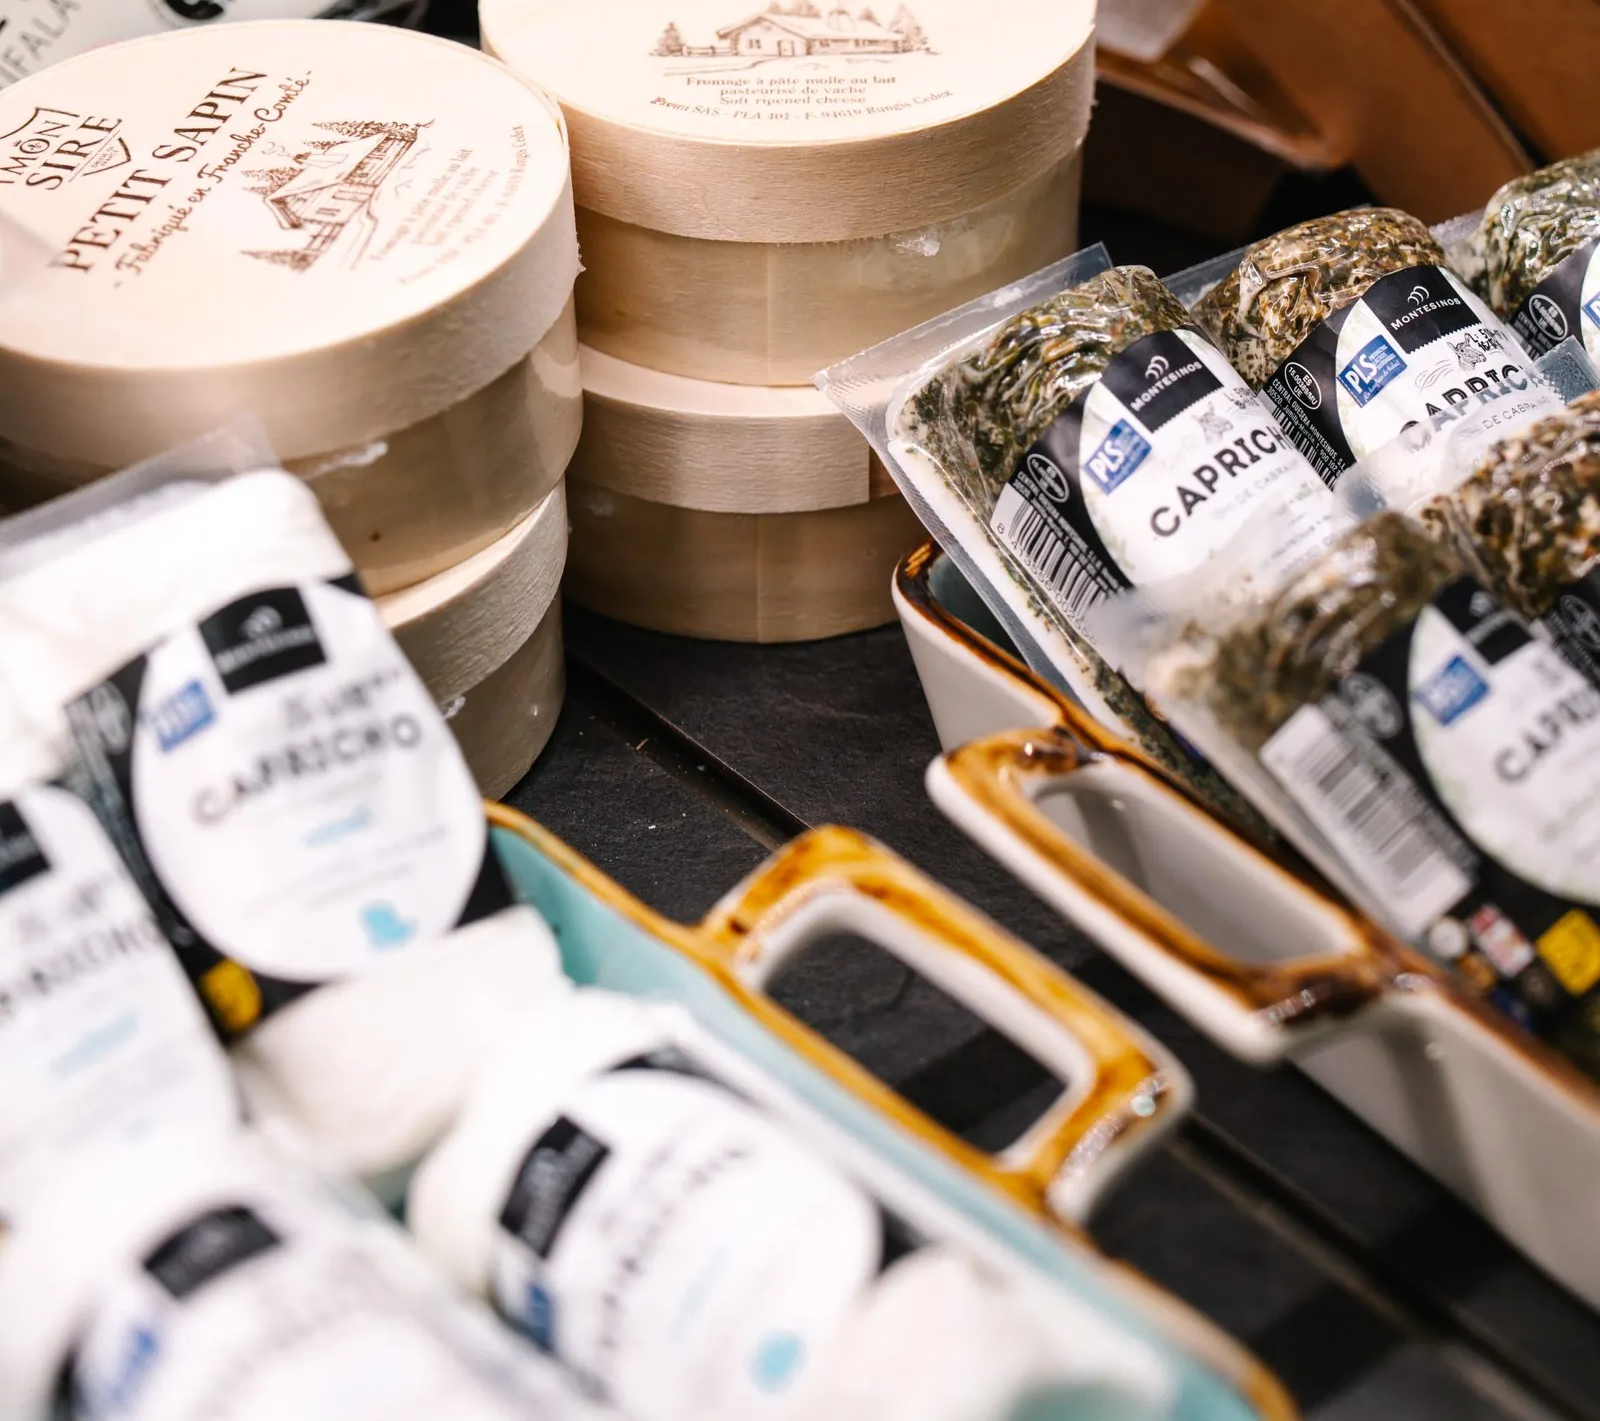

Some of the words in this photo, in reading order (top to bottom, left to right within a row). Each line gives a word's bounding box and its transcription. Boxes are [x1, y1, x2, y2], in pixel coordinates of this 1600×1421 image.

[685, 77, 751, 88] Fromage
[805, 76, 846, 85] molle
[873, 76, 897, 85] lait
[802, 86, 818, 95] de
[824, 86, 867, 95] vache
[719, 96, 748, 106] Soft
[755, 96, 811, 107] ripened
[815, 95, 867, 105] cheese
[25, 115, 123, 191] SIRE
[64, 168, 172, 274] PETIT
[151, 66, 268, 163] SAPIN
[115, 204, 193, 276] Fabriqué
[187, 185, 212, 205] en
[1390, 297, 1462, 332] MONTESINOS
[1130, 360, 1203, 412] MONTESINOS
[1271, 378, 1293, 405] CENTRAL
[1293, 385, 1303, 398] UE
[1302, 374, 1313, 387] ES
[1344, 353, 1378, 395] PLS
[1088, 439, 1126, 484] PLS
